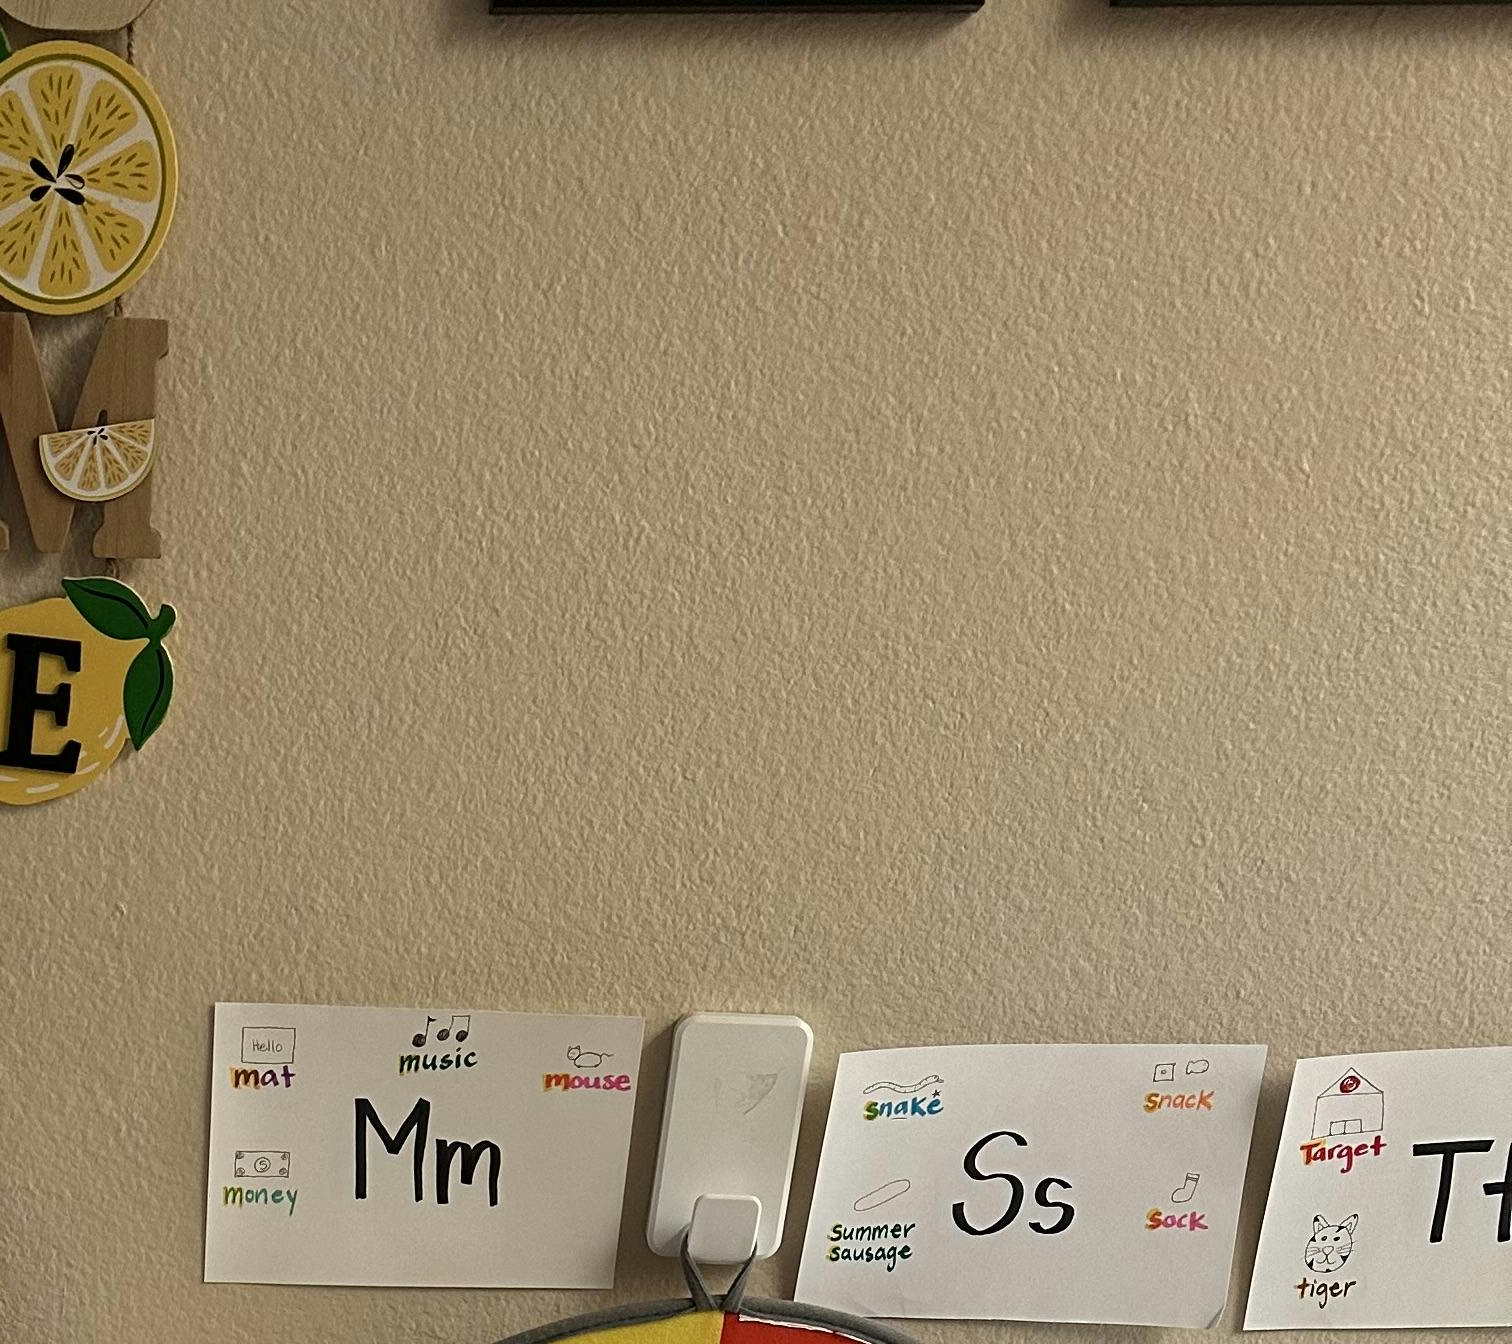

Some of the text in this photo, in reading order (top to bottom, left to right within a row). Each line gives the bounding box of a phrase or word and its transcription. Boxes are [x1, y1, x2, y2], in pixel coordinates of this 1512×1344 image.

[251, 1039, 284, 1053] Hello
[399, 1047, 478, 1075] music
[231, 1065, 296, 1088] mat
[543, 1073, 632, 1091] mouse
[863, 1096, 944, 1120] snake
[354, 1097, 501, 1207] Mm
[1300, 1135, 1387, 1174] Target
[952, 1131, 1075, 1236] Ss
[223, 1186, 298, 1216] money
[829, 1243, 912, 1273] sausage
[1296, 1277, 1357, 1309] tiger
